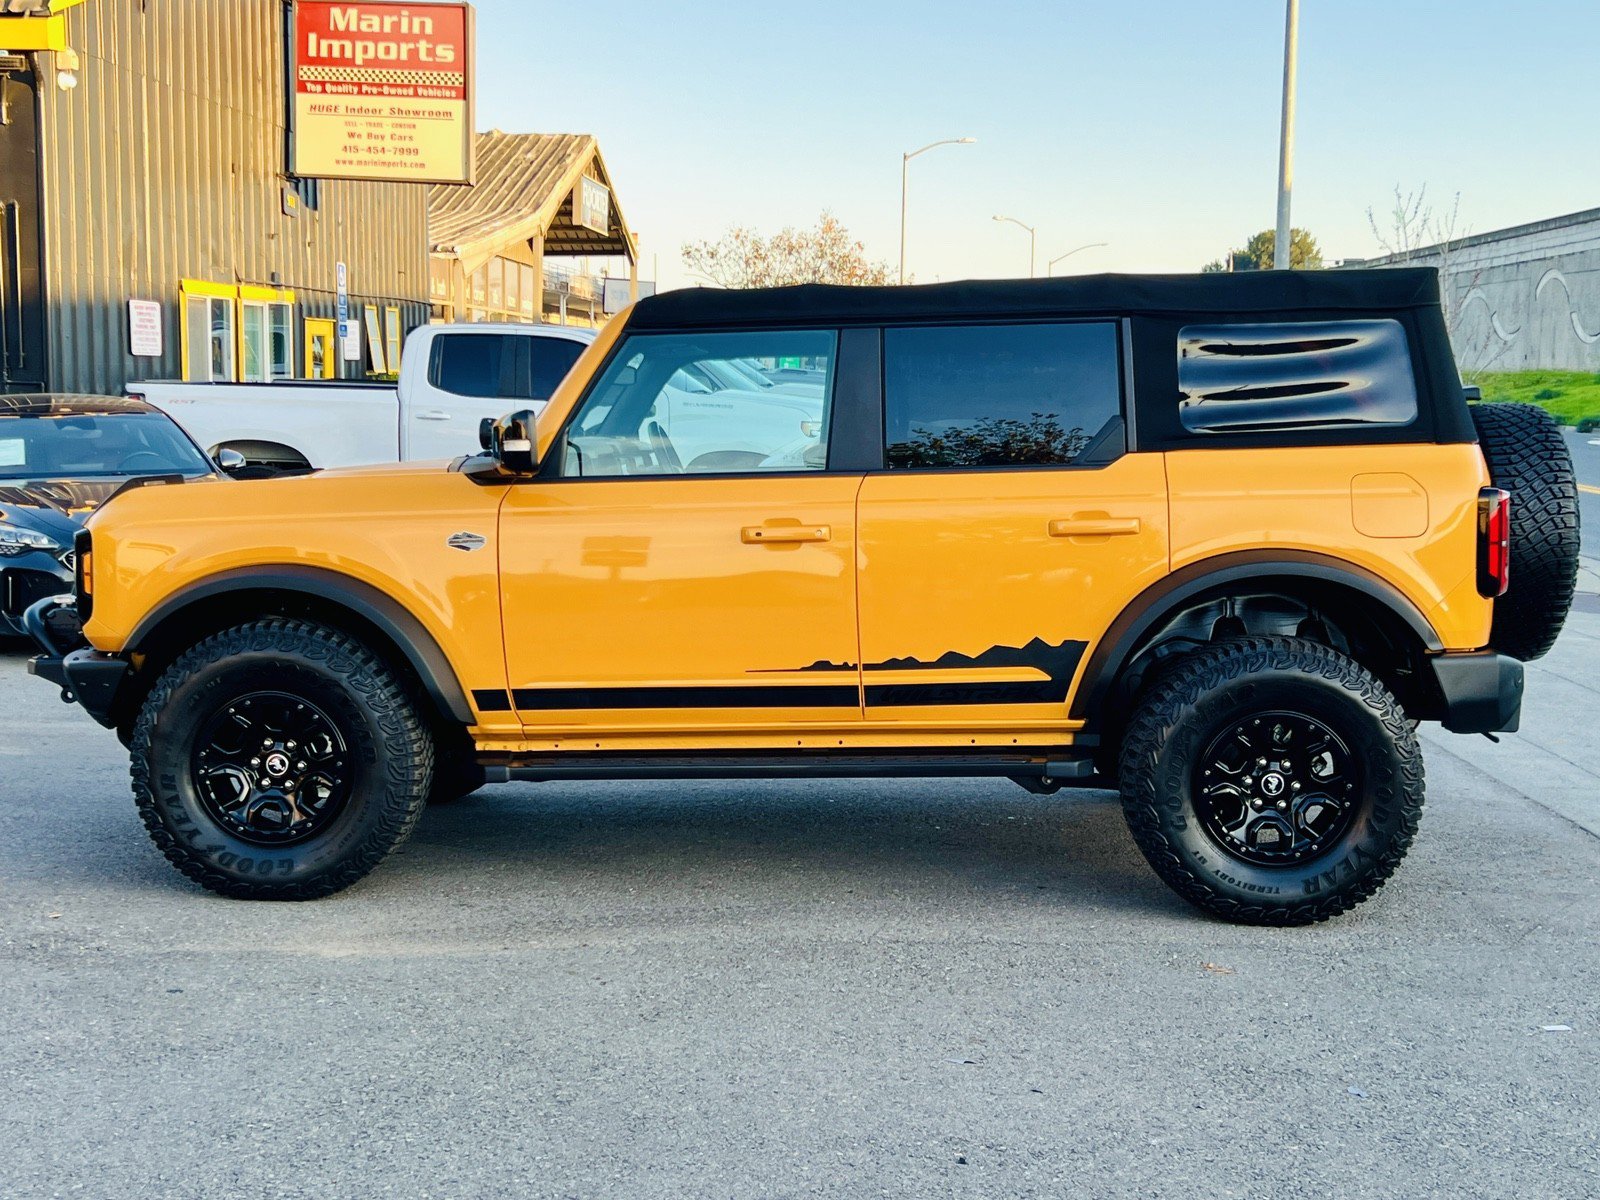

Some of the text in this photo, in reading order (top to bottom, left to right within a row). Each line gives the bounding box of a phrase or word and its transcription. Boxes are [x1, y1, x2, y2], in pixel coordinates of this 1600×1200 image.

[329, 6, 433, 35] Marin
[307, 32, 455, 66] Imports
[305, 82, 457, 98] Top Quality Pre-Owned Vehicles
[309, 104, 453, 118] HUGE Indoor Showroom
[347, 131, 415, 142] We Buy Cars
[342, 145, 419, 156] 415-454-7999
[335, 158, 426, 169] www.marinimports.com
[158, 773, 296, 877] GOODYEAR
[1211, 866, 1281, 897] TERRITORY
